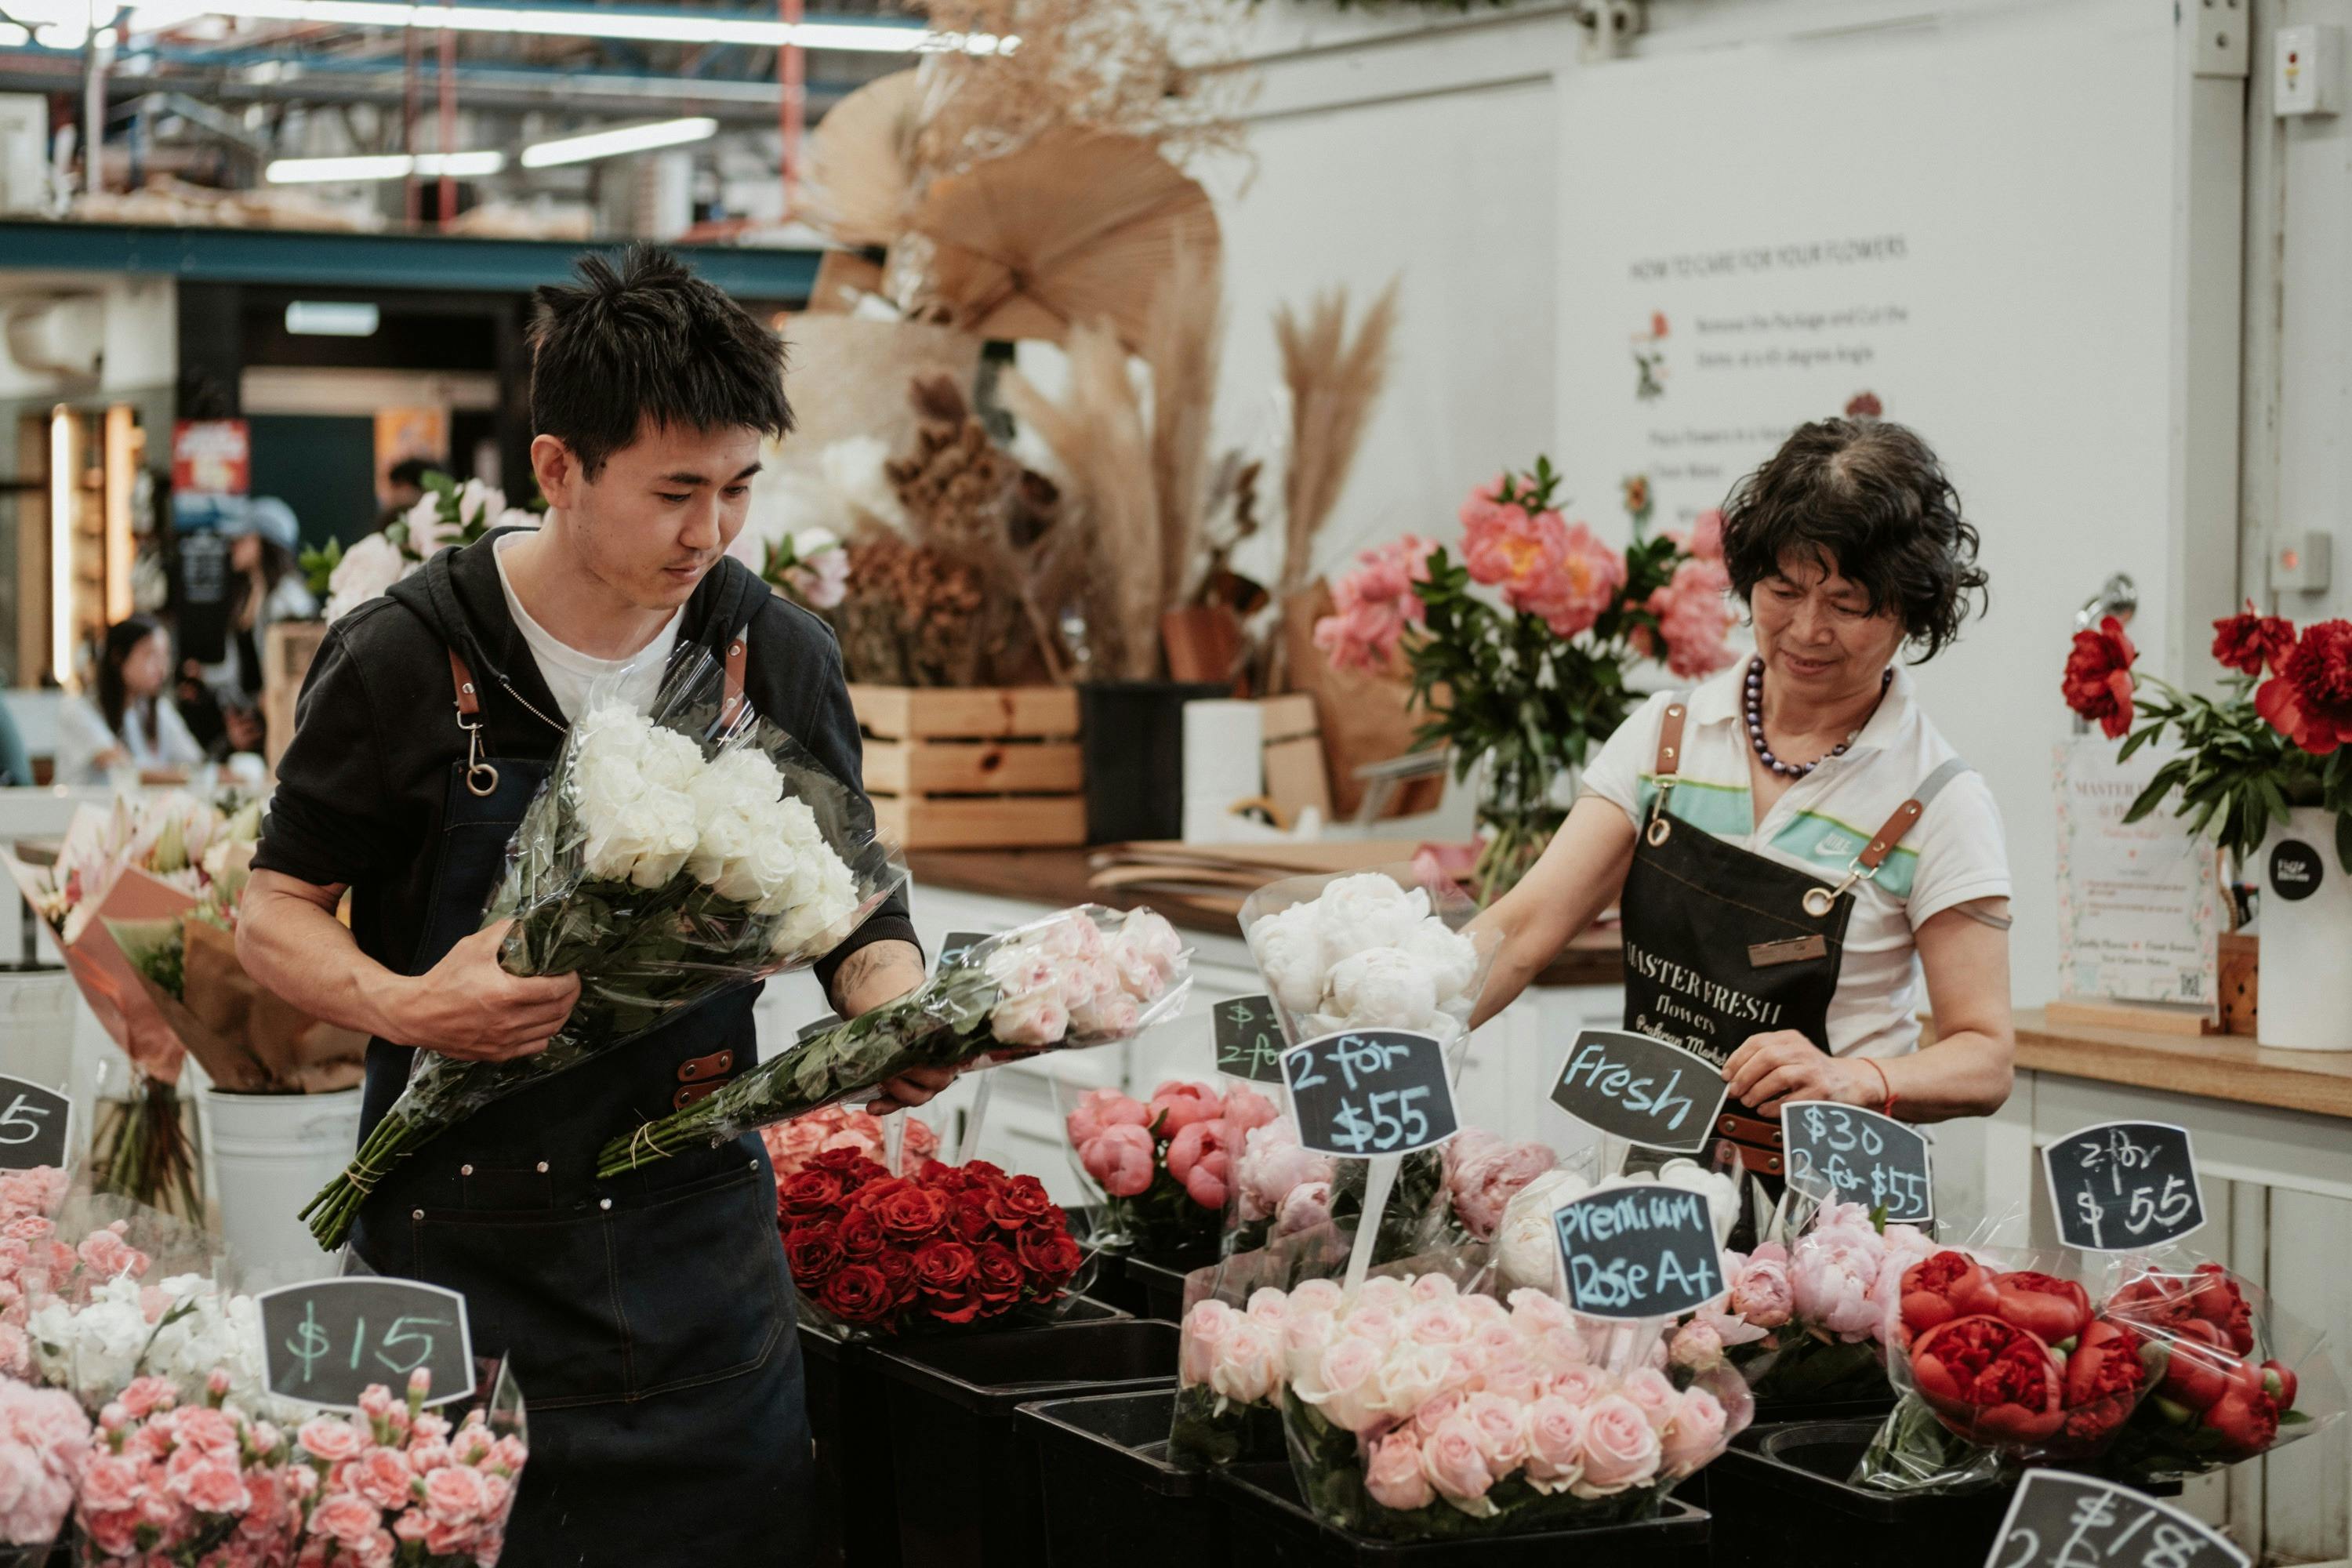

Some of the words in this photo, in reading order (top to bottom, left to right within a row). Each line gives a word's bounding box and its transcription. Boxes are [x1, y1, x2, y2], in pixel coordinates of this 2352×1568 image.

[1777, 243, 1820, 269] YOUR
[1825, 236, 1907, 264] FLOWERS
[1218, 1045, 1251, 1064] 2
[1289, 1049, 1327, 1091] 2
[1324, 1035, 1410, 1091] for
[1330, 1085, 1431, 1152] $55
[1801, 1105, 1883, 1156] $30
[1791, 1148, 1822, 1184] 2
[1820, 1153, 1867, 1191] for
[1871, 1162, 1926, 1214] $55
[2079, 1142, 2105, 1170] 2
[2104, 1127, 2162, 1196] for
[1656, 1250, 1717, 1300] A+
[285, 1299, 453, 1382] $15
